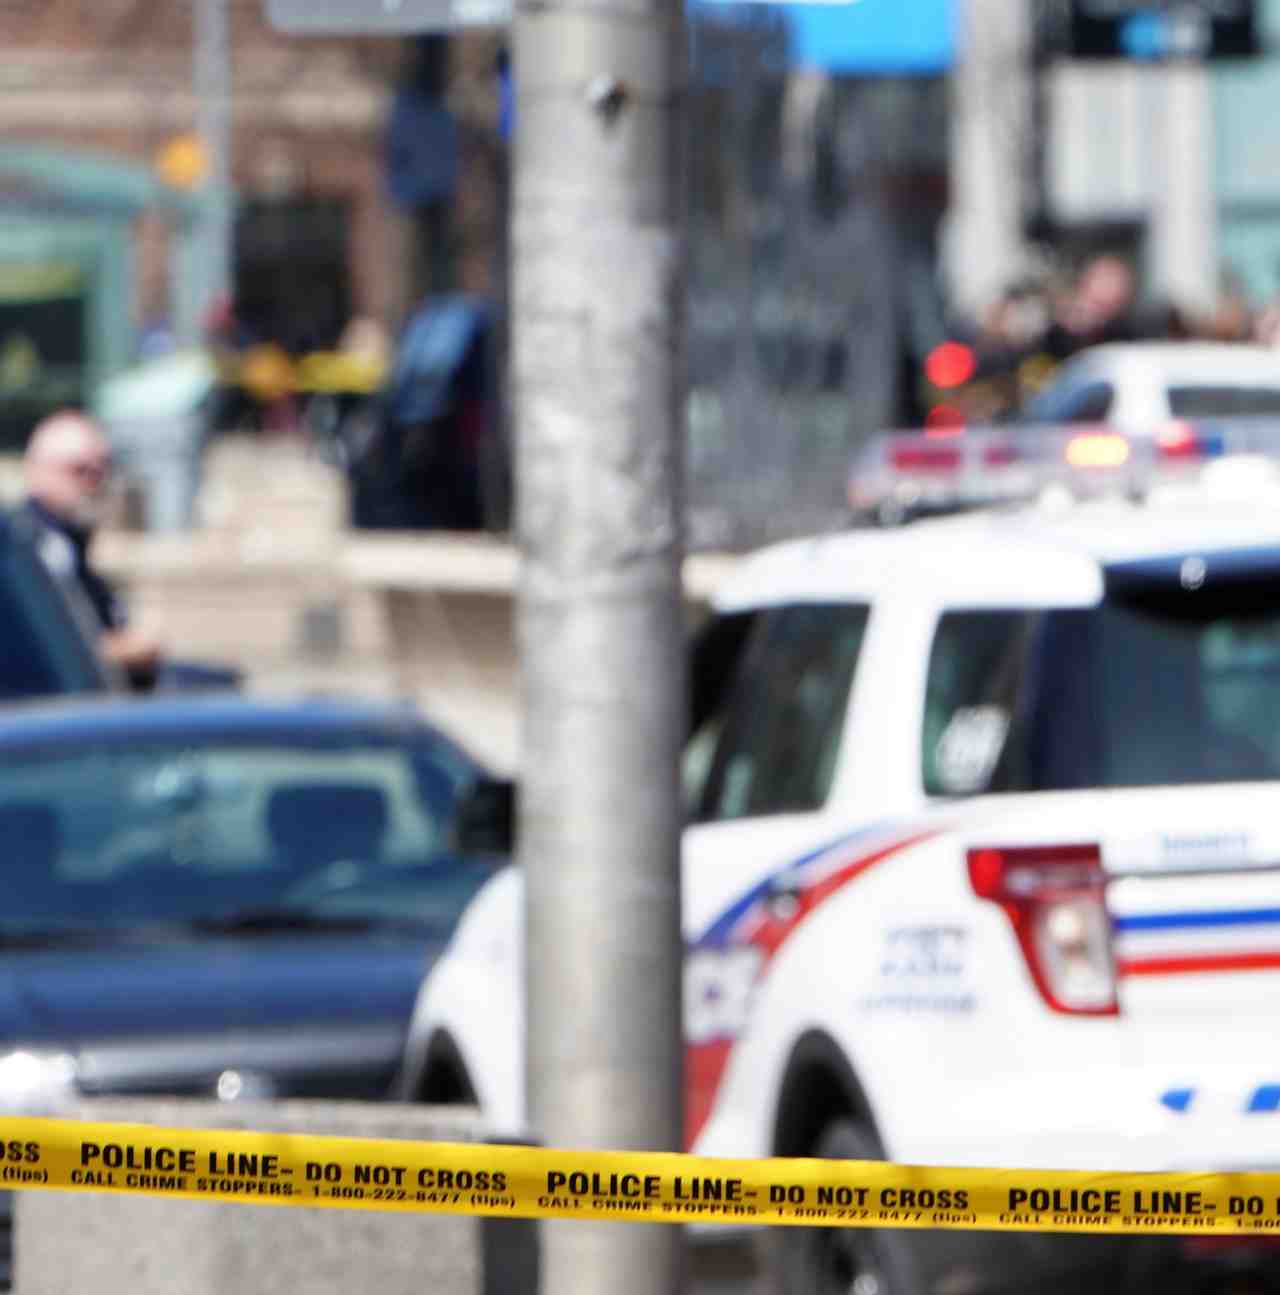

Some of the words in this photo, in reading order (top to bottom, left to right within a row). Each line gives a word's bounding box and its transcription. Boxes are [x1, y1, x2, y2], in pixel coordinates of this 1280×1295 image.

[81, 1142, 195, 1173] POLICE
[306, 1162, 341, 1182] DO
[355, 1165, 406, 1187] NOT
[418, 1168, 506, 1191] CROSS
[547, 1172, 660, 1198] POLICE
[770, 1185, 804, 1203] DO
[818, 1187, 867, 1206] NOT
[881, 1189, 968, 1209] CROSS
[1008, 1189, 1120, 1212] POLICE
[1229, 1197, 1263, 1215] DO
